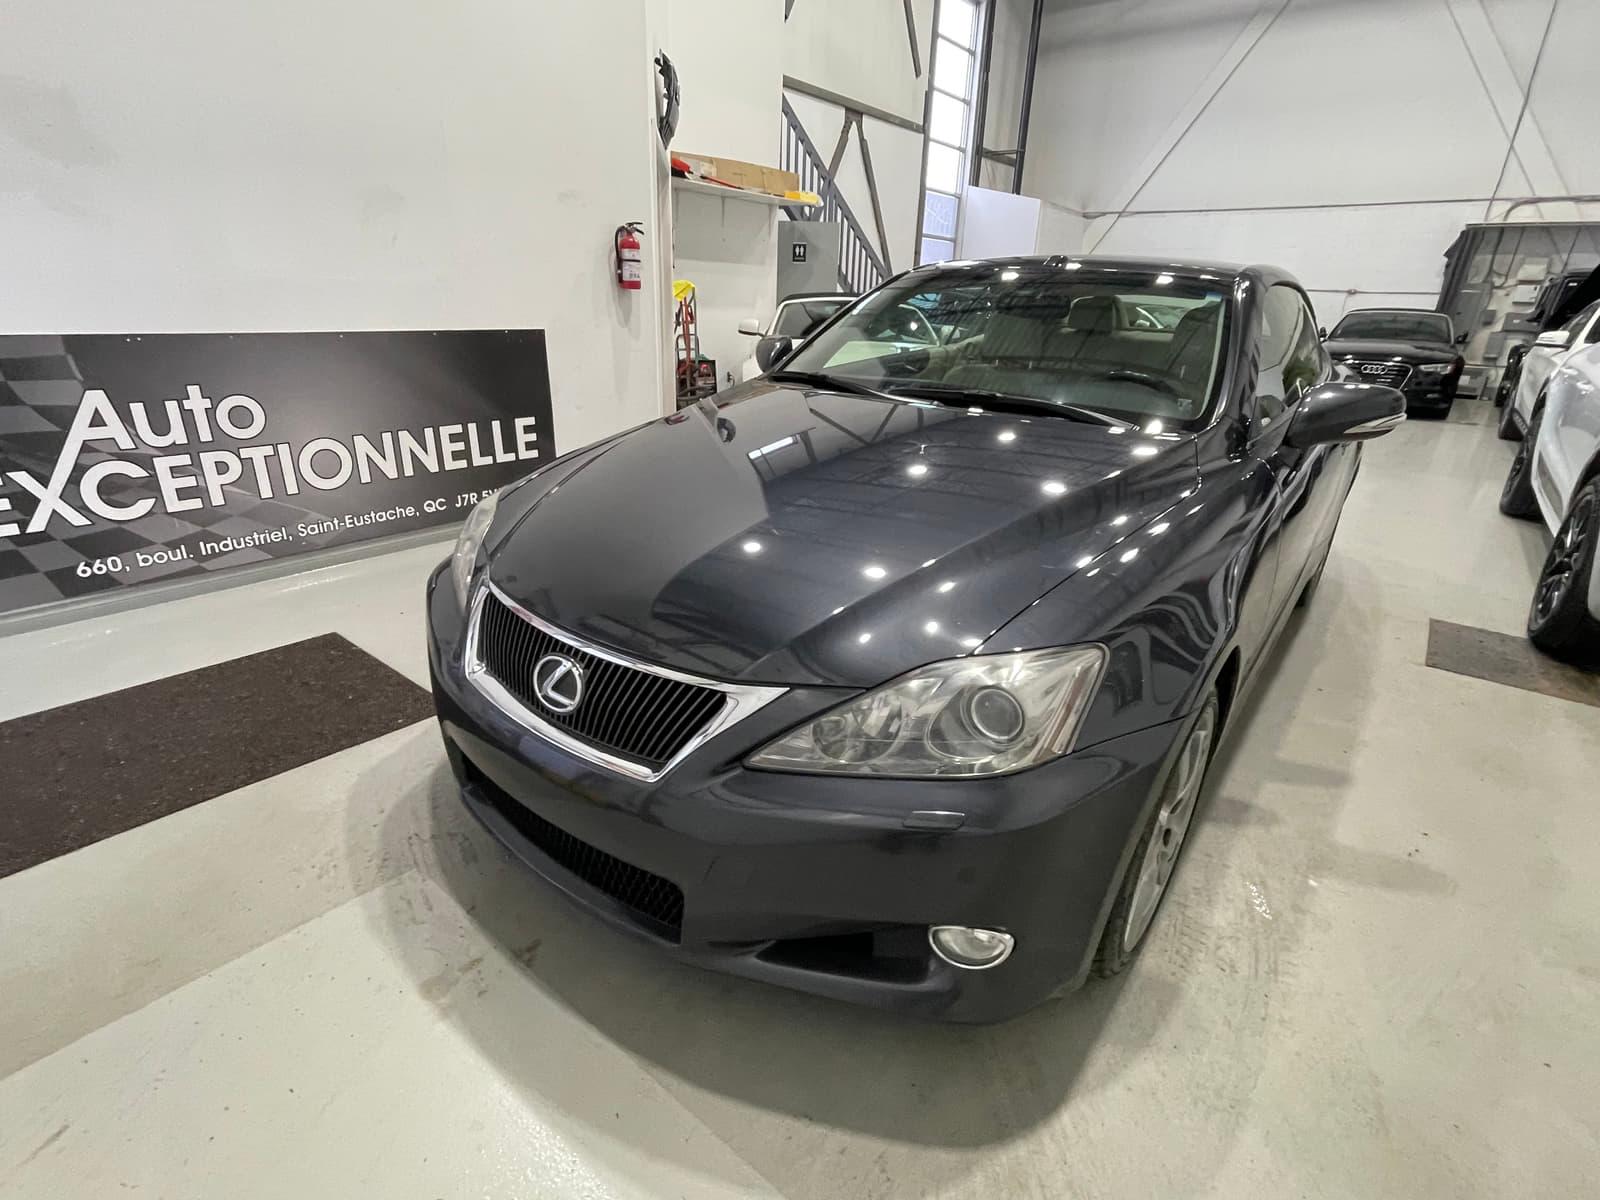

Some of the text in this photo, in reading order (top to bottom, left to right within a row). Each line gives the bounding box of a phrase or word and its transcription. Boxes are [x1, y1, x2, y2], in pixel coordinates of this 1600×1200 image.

[66, 384, 267, 450] Auto
[76, 492, 478, 578] 660, boul. Industriel, Saint-Eustache, QC J7R
